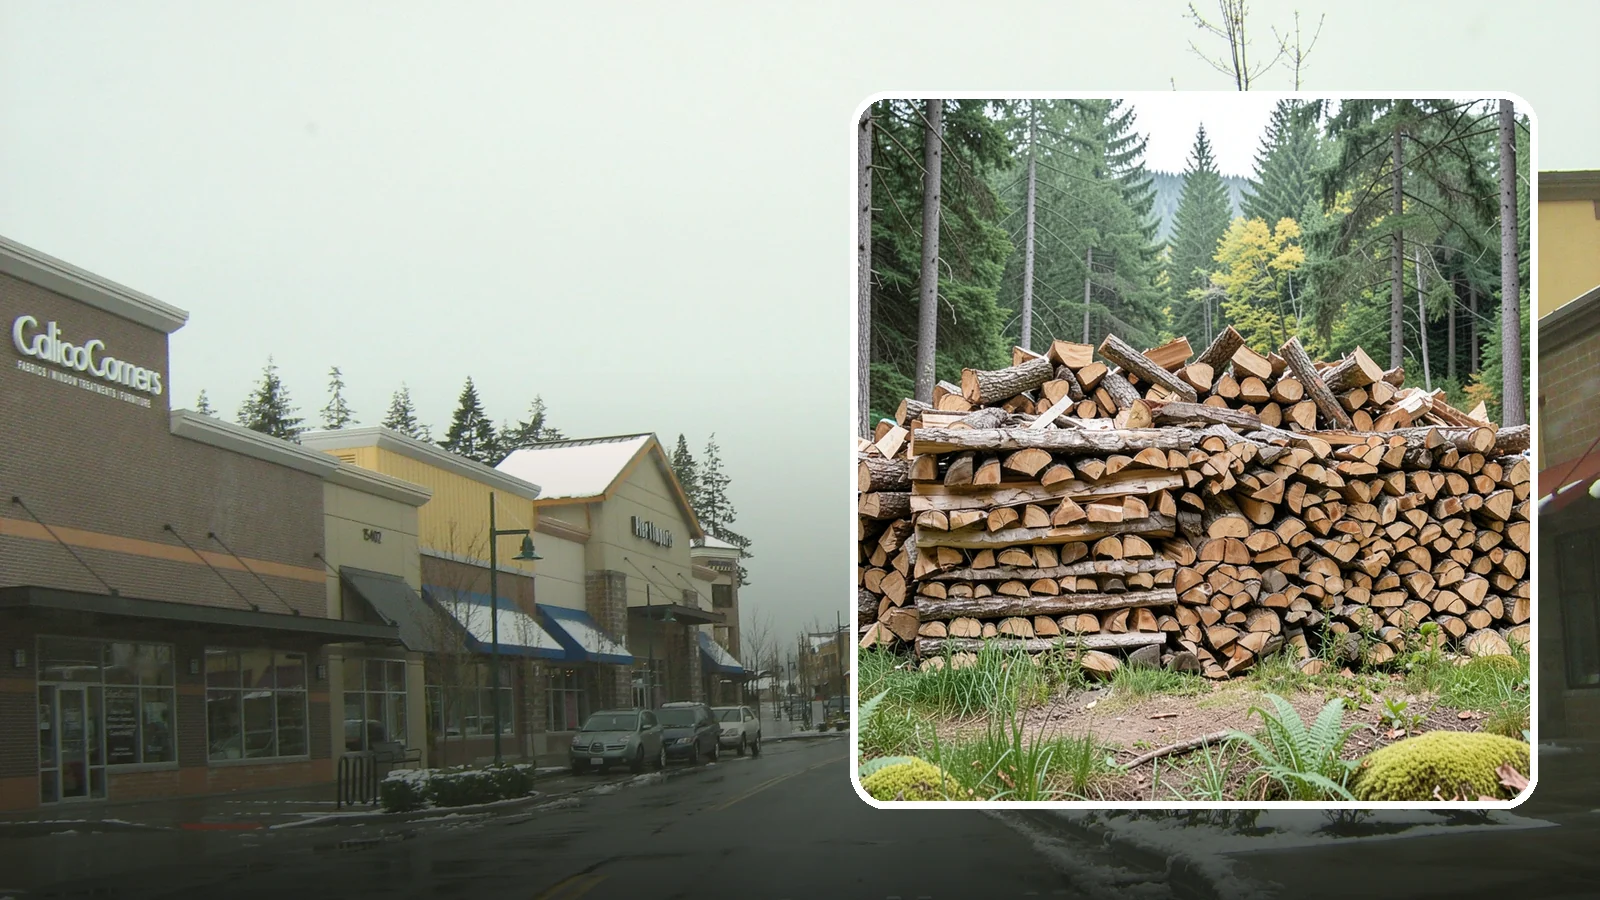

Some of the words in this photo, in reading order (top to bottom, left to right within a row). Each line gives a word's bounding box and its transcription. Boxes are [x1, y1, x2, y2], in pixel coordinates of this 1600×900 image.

[17, 360, 47, 377] FABRICS
[51, 370, 79, 387] WINDOW
[79, 378, 117, 399] TREATMENTS
[120, 391, 151, 408] FURNITURE
